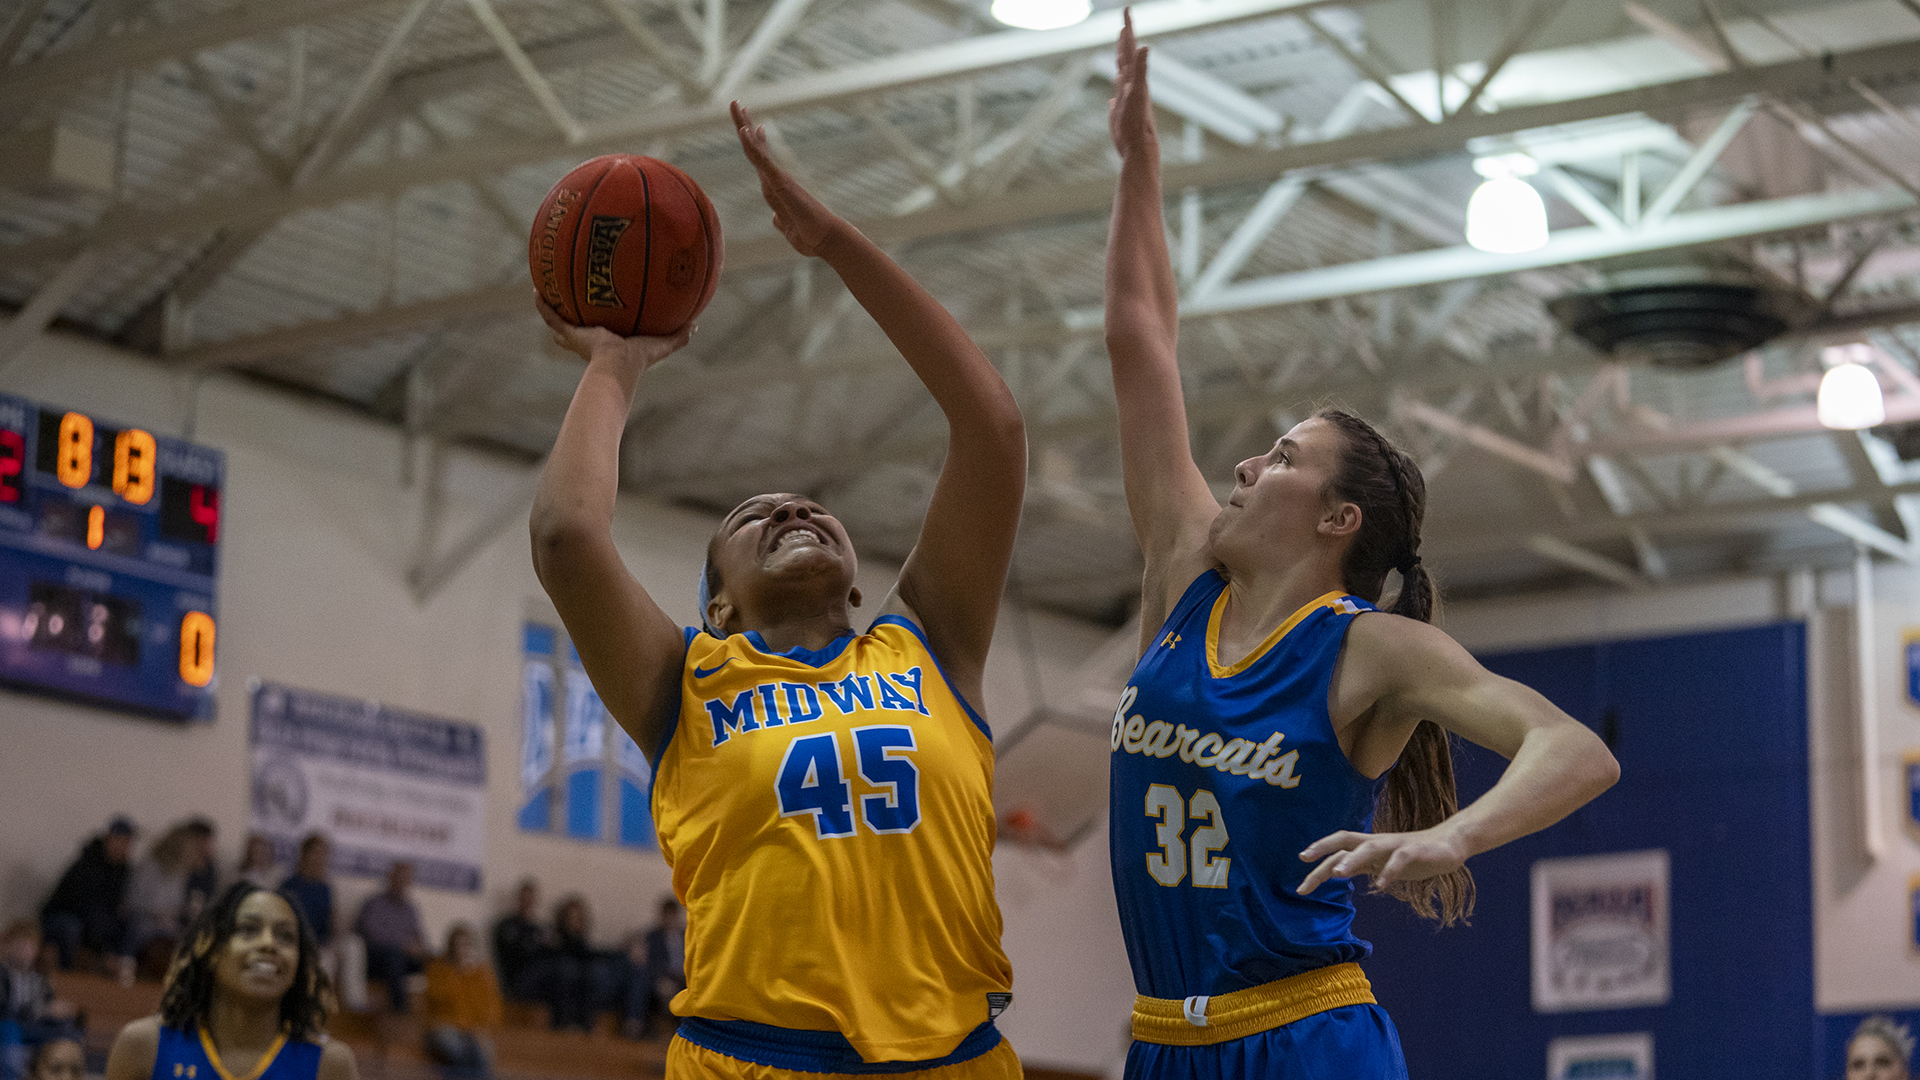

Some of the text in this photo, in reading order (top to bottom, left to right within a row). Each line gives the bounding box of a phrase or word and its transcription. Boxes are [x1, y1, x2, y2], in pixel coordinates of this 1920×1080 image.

[588, 218, 631, 306] NAIA
[87, 505, 105, 550] 1
[190, 483, 221, 546] 4
[179, 611, 216, 687] 0
[703, 666, 932, 748] MIDWAY
[774, 724, 922, 840] 45
[1145, 783, 1232, 889] 32
